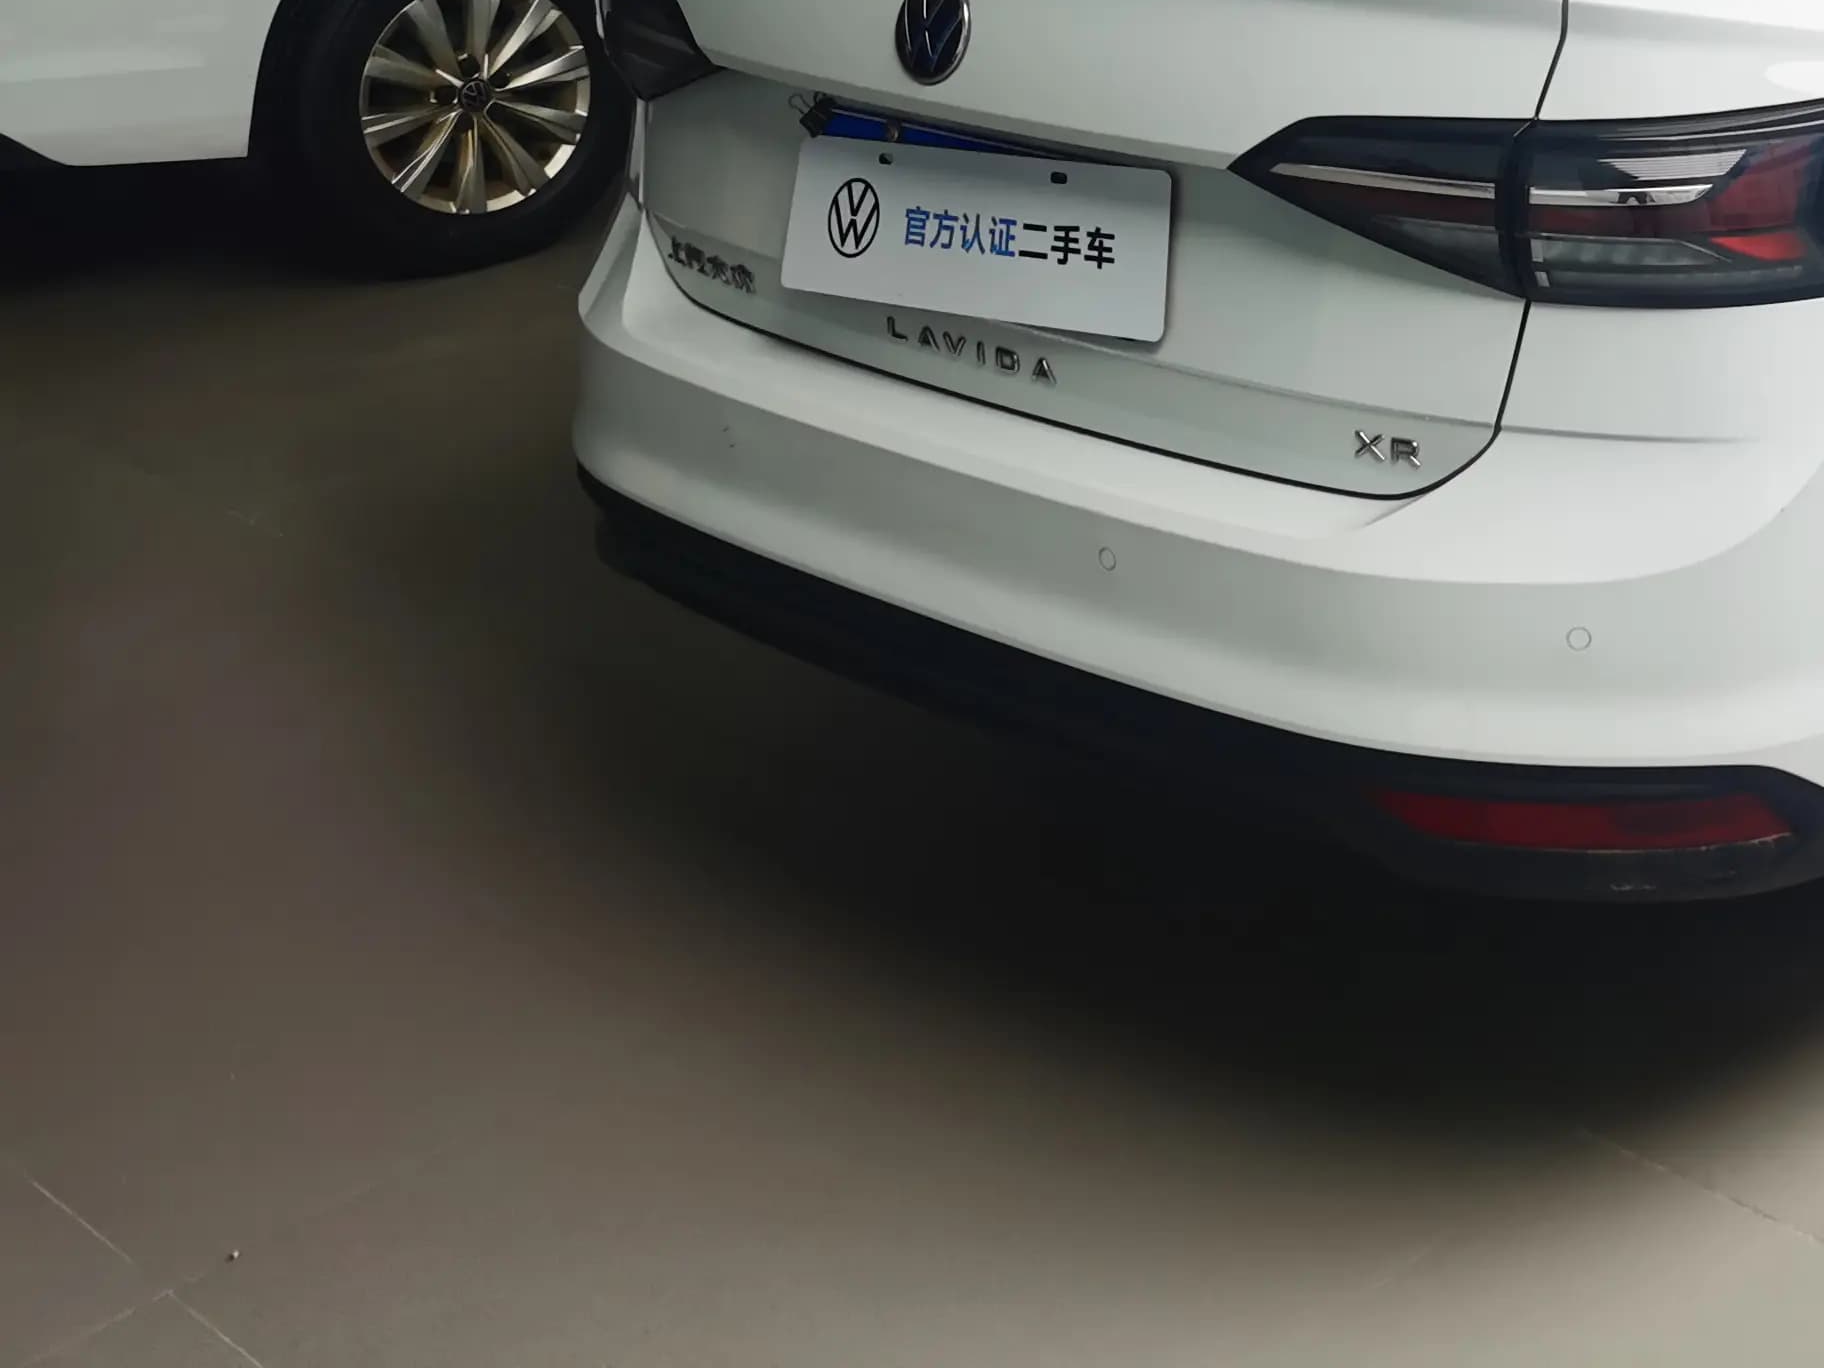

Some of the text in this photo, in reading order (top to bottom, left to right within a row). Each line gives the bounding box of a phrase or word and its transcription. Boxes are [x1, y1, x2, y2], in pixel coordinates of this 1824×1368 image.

[904, 205, 1116, 270] 官方认证二手车
[886, 315, 1057, 384] LAVIDA
[1354, 429, 1421, 469] XR
